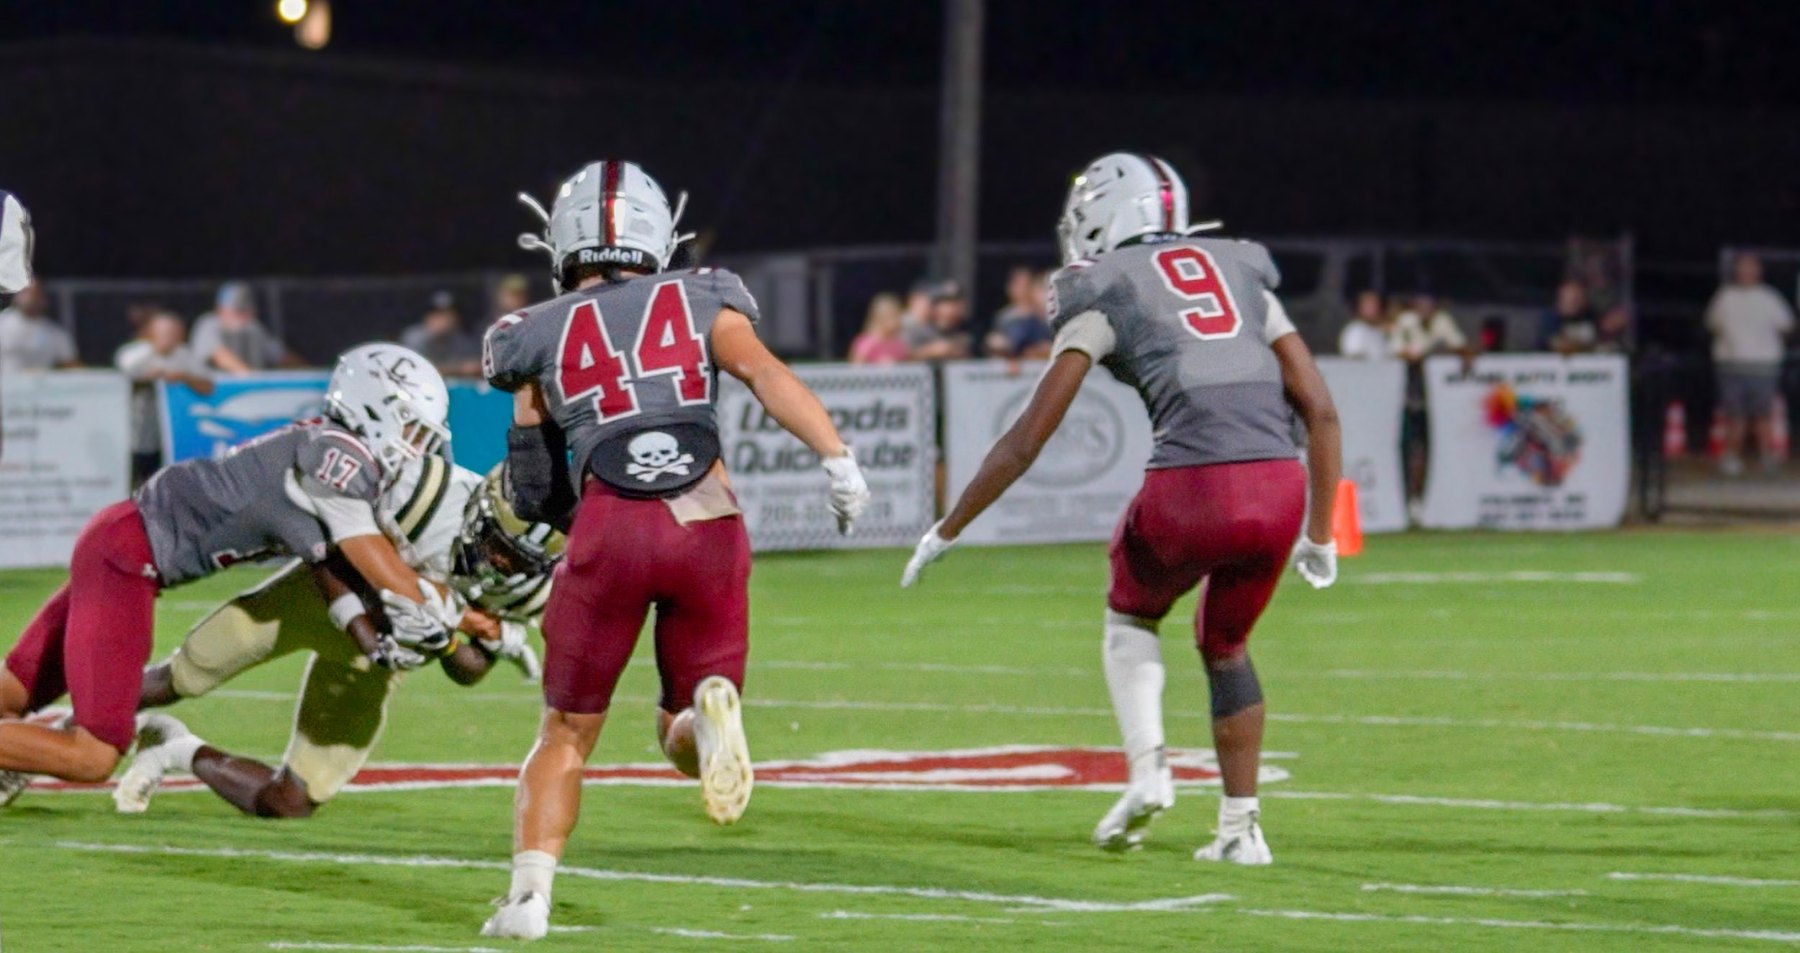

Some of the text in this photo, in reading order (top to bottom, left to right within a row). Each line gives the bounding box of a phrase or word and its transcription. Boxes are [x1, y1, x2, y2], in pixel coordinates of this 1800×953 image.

[579, 247, 643, 265] Riddell
[1151, 245, 1243, 340] 9
[555, 278, 710, 424] 44
[314, 447, 362, 490] 17
[733, 438, 822, 474] Quic
